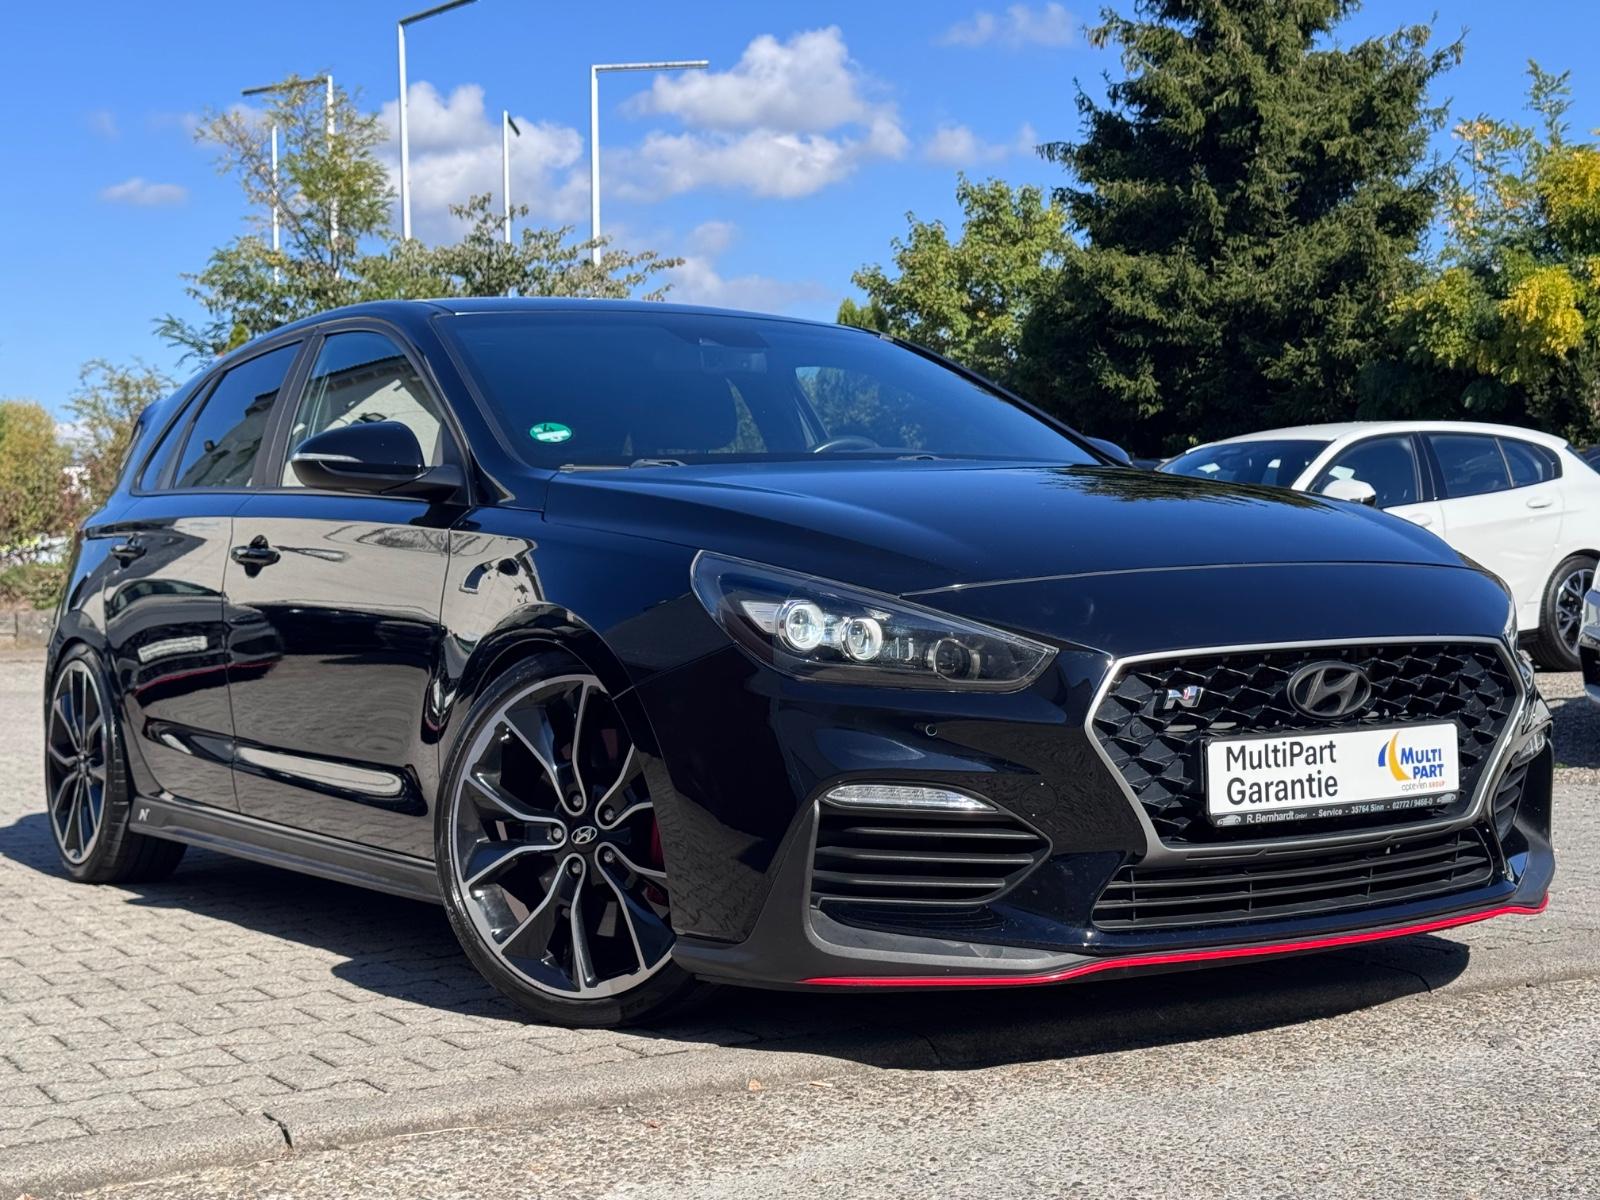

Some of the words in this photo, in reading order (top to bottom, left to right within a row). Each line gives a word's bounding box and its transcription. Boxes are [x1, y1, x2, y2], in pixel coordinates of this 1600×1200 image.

[1226, 740, 1336, 772] MultiPart
[1400, 747, 1442, 765] MULTI
[1413, 764, 1444, 779] PART
[1226, 769, 1338, 805] Garantie
[138, 808, 150, 821] N
[1318, 808, 1343, 817] Service
[1351, 805, 1369, 814] 35764
[1370, 803, 1385, 812] Sinn
